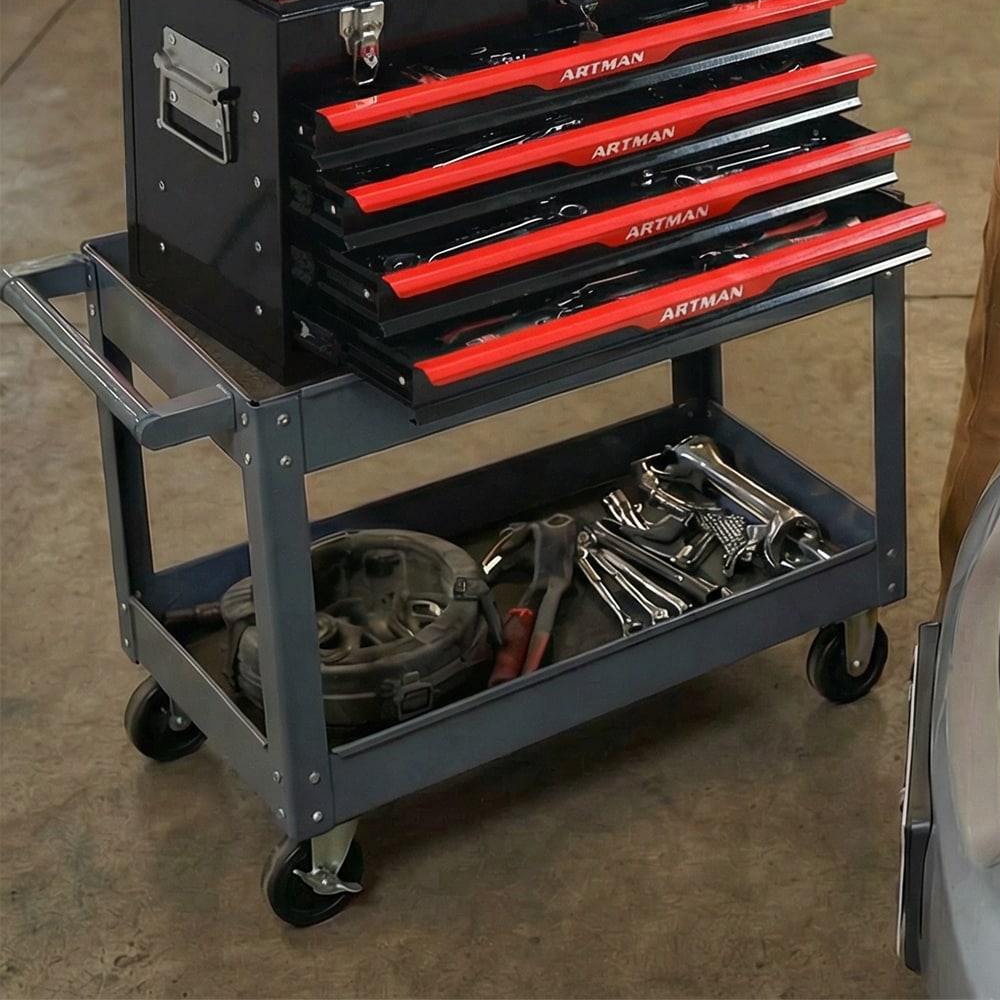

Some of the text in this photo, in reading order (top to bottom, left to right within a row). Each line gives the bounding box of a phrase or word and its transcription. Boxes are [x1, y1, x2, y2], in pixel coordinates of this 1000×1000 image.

[560, 51, 644, 82] ARTMAN
[591, 126, 675, 159] ARTMAN
[625, 204, 709, 240] ARTMAN
[659, 285, 743, 323] ARTMAN
